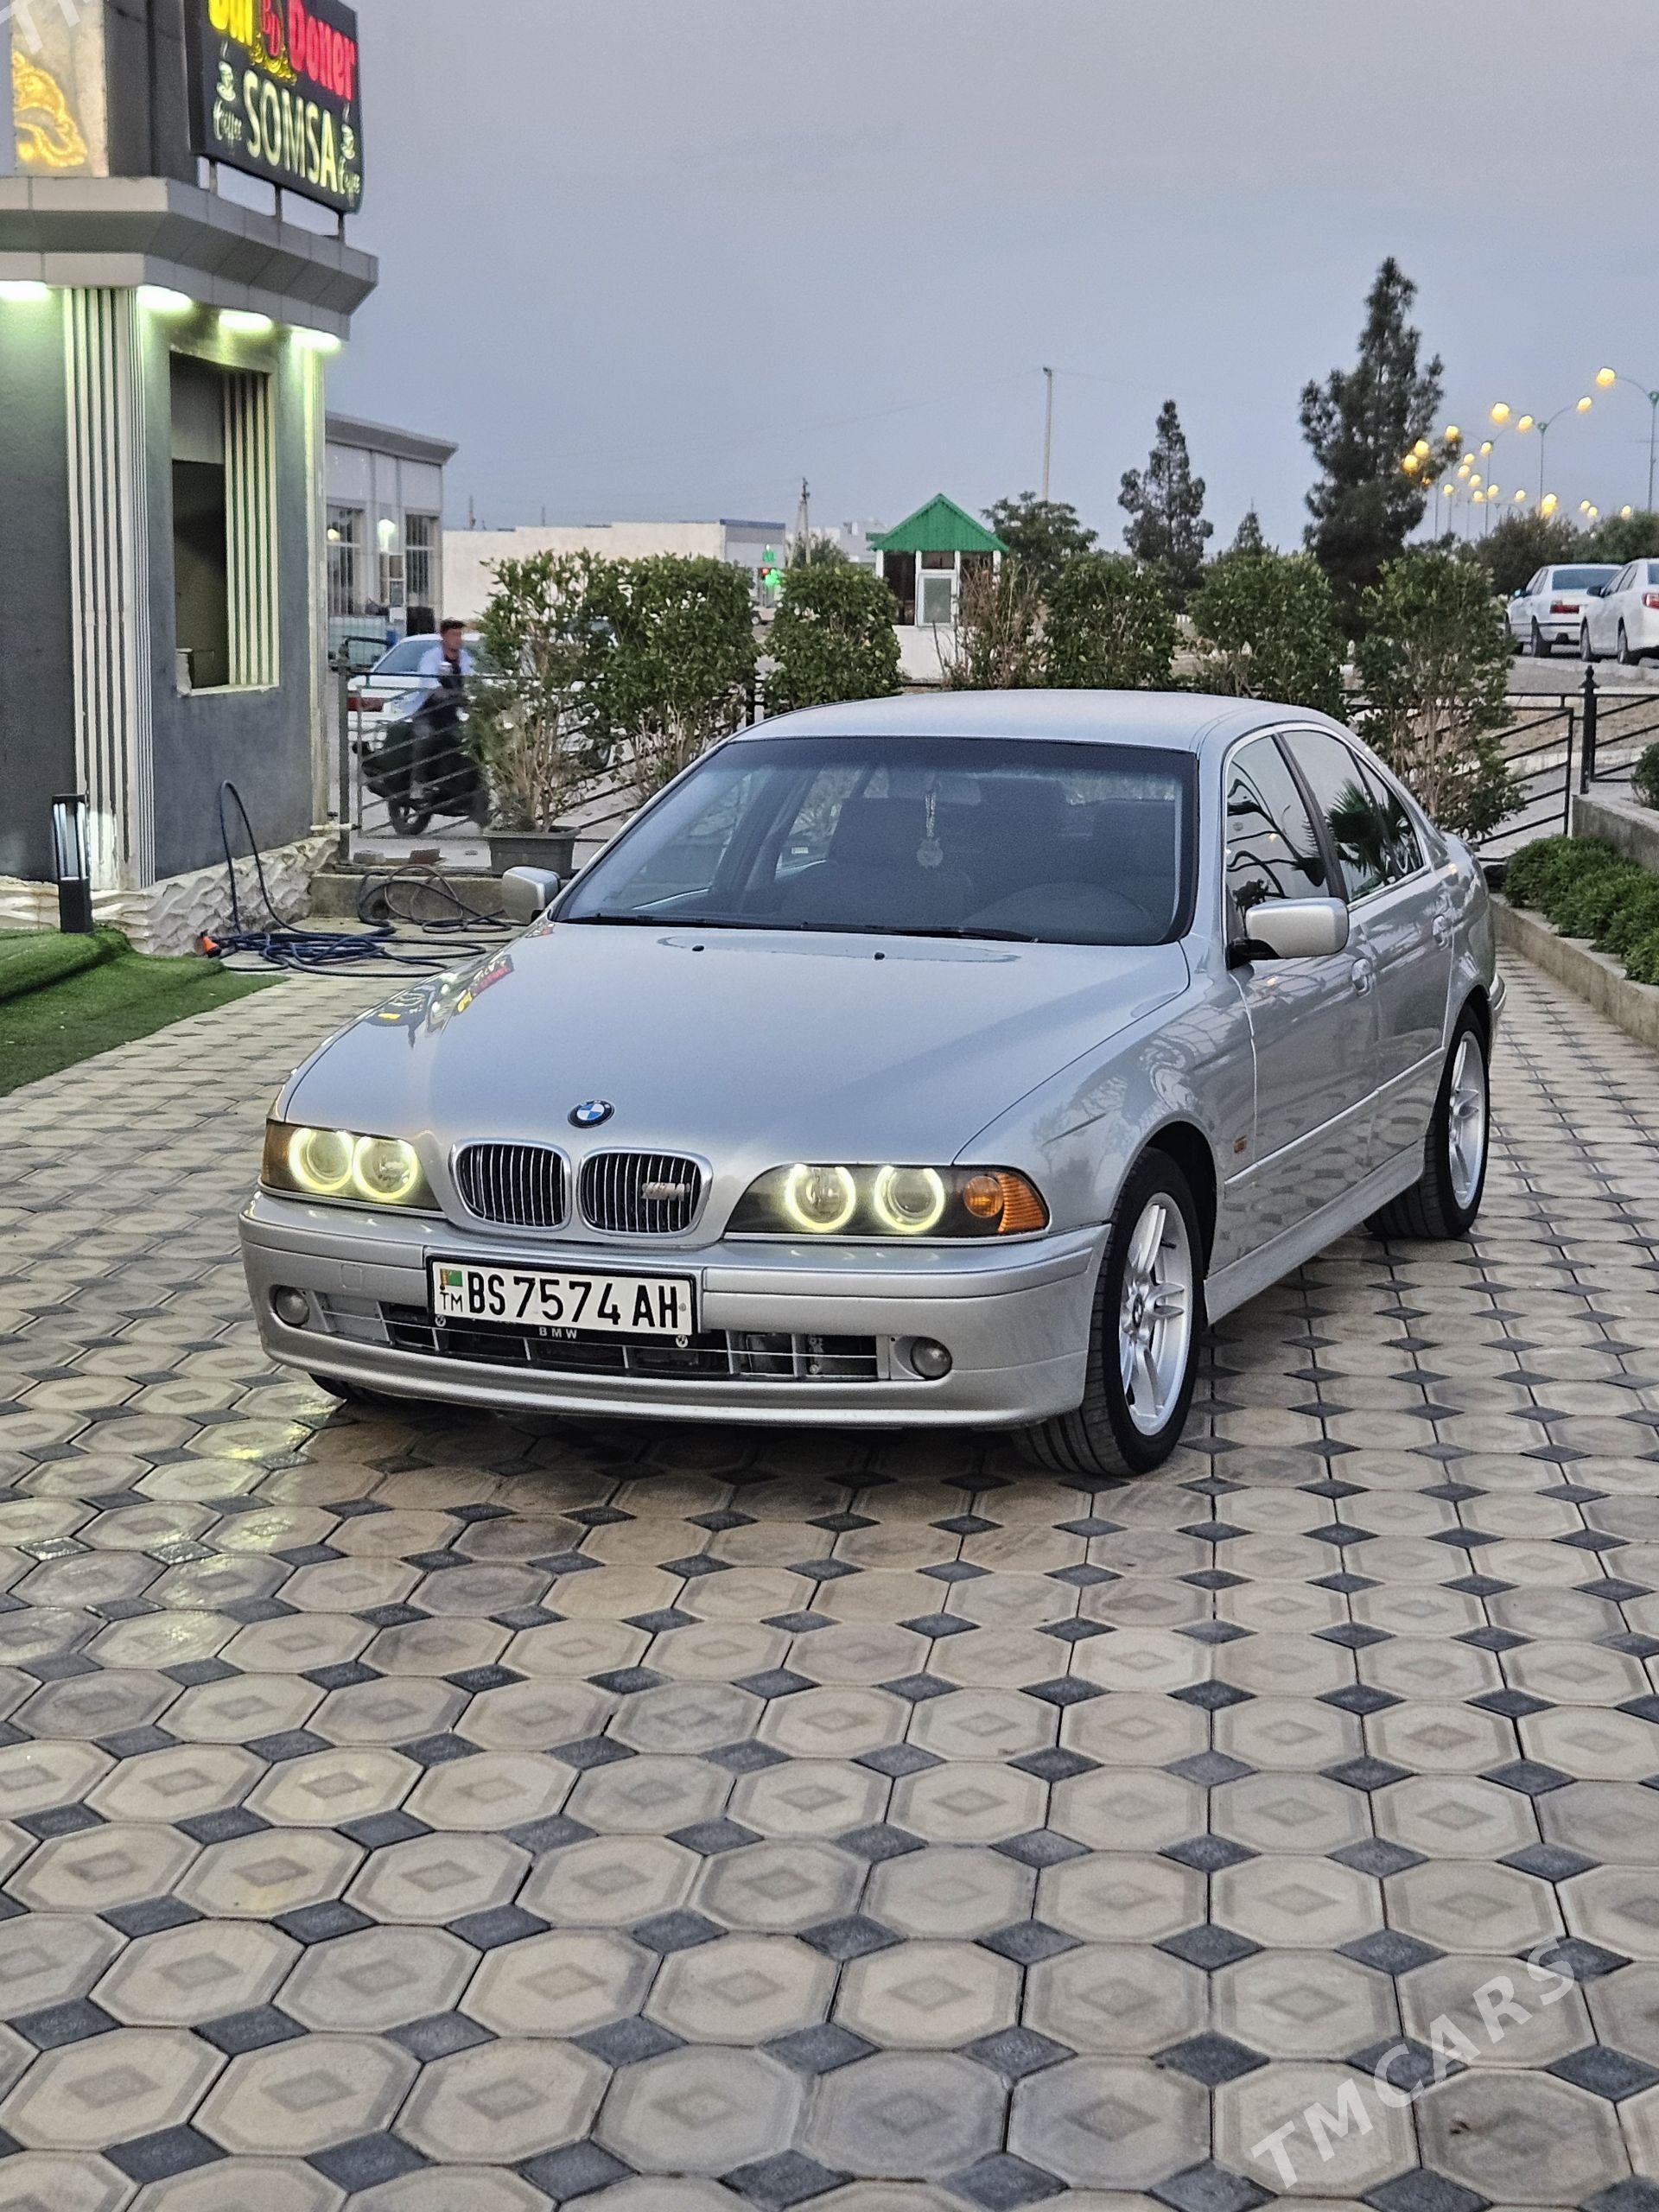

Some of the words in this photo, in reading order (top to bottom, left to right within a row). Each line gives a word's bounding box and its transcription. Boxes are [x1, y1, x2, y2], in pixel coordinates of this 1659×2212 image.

[243, 69, 338, 193] SOMSA
[440, 1291, 463, 1313] TM
[538, 1326, 578, 1339] BMW
